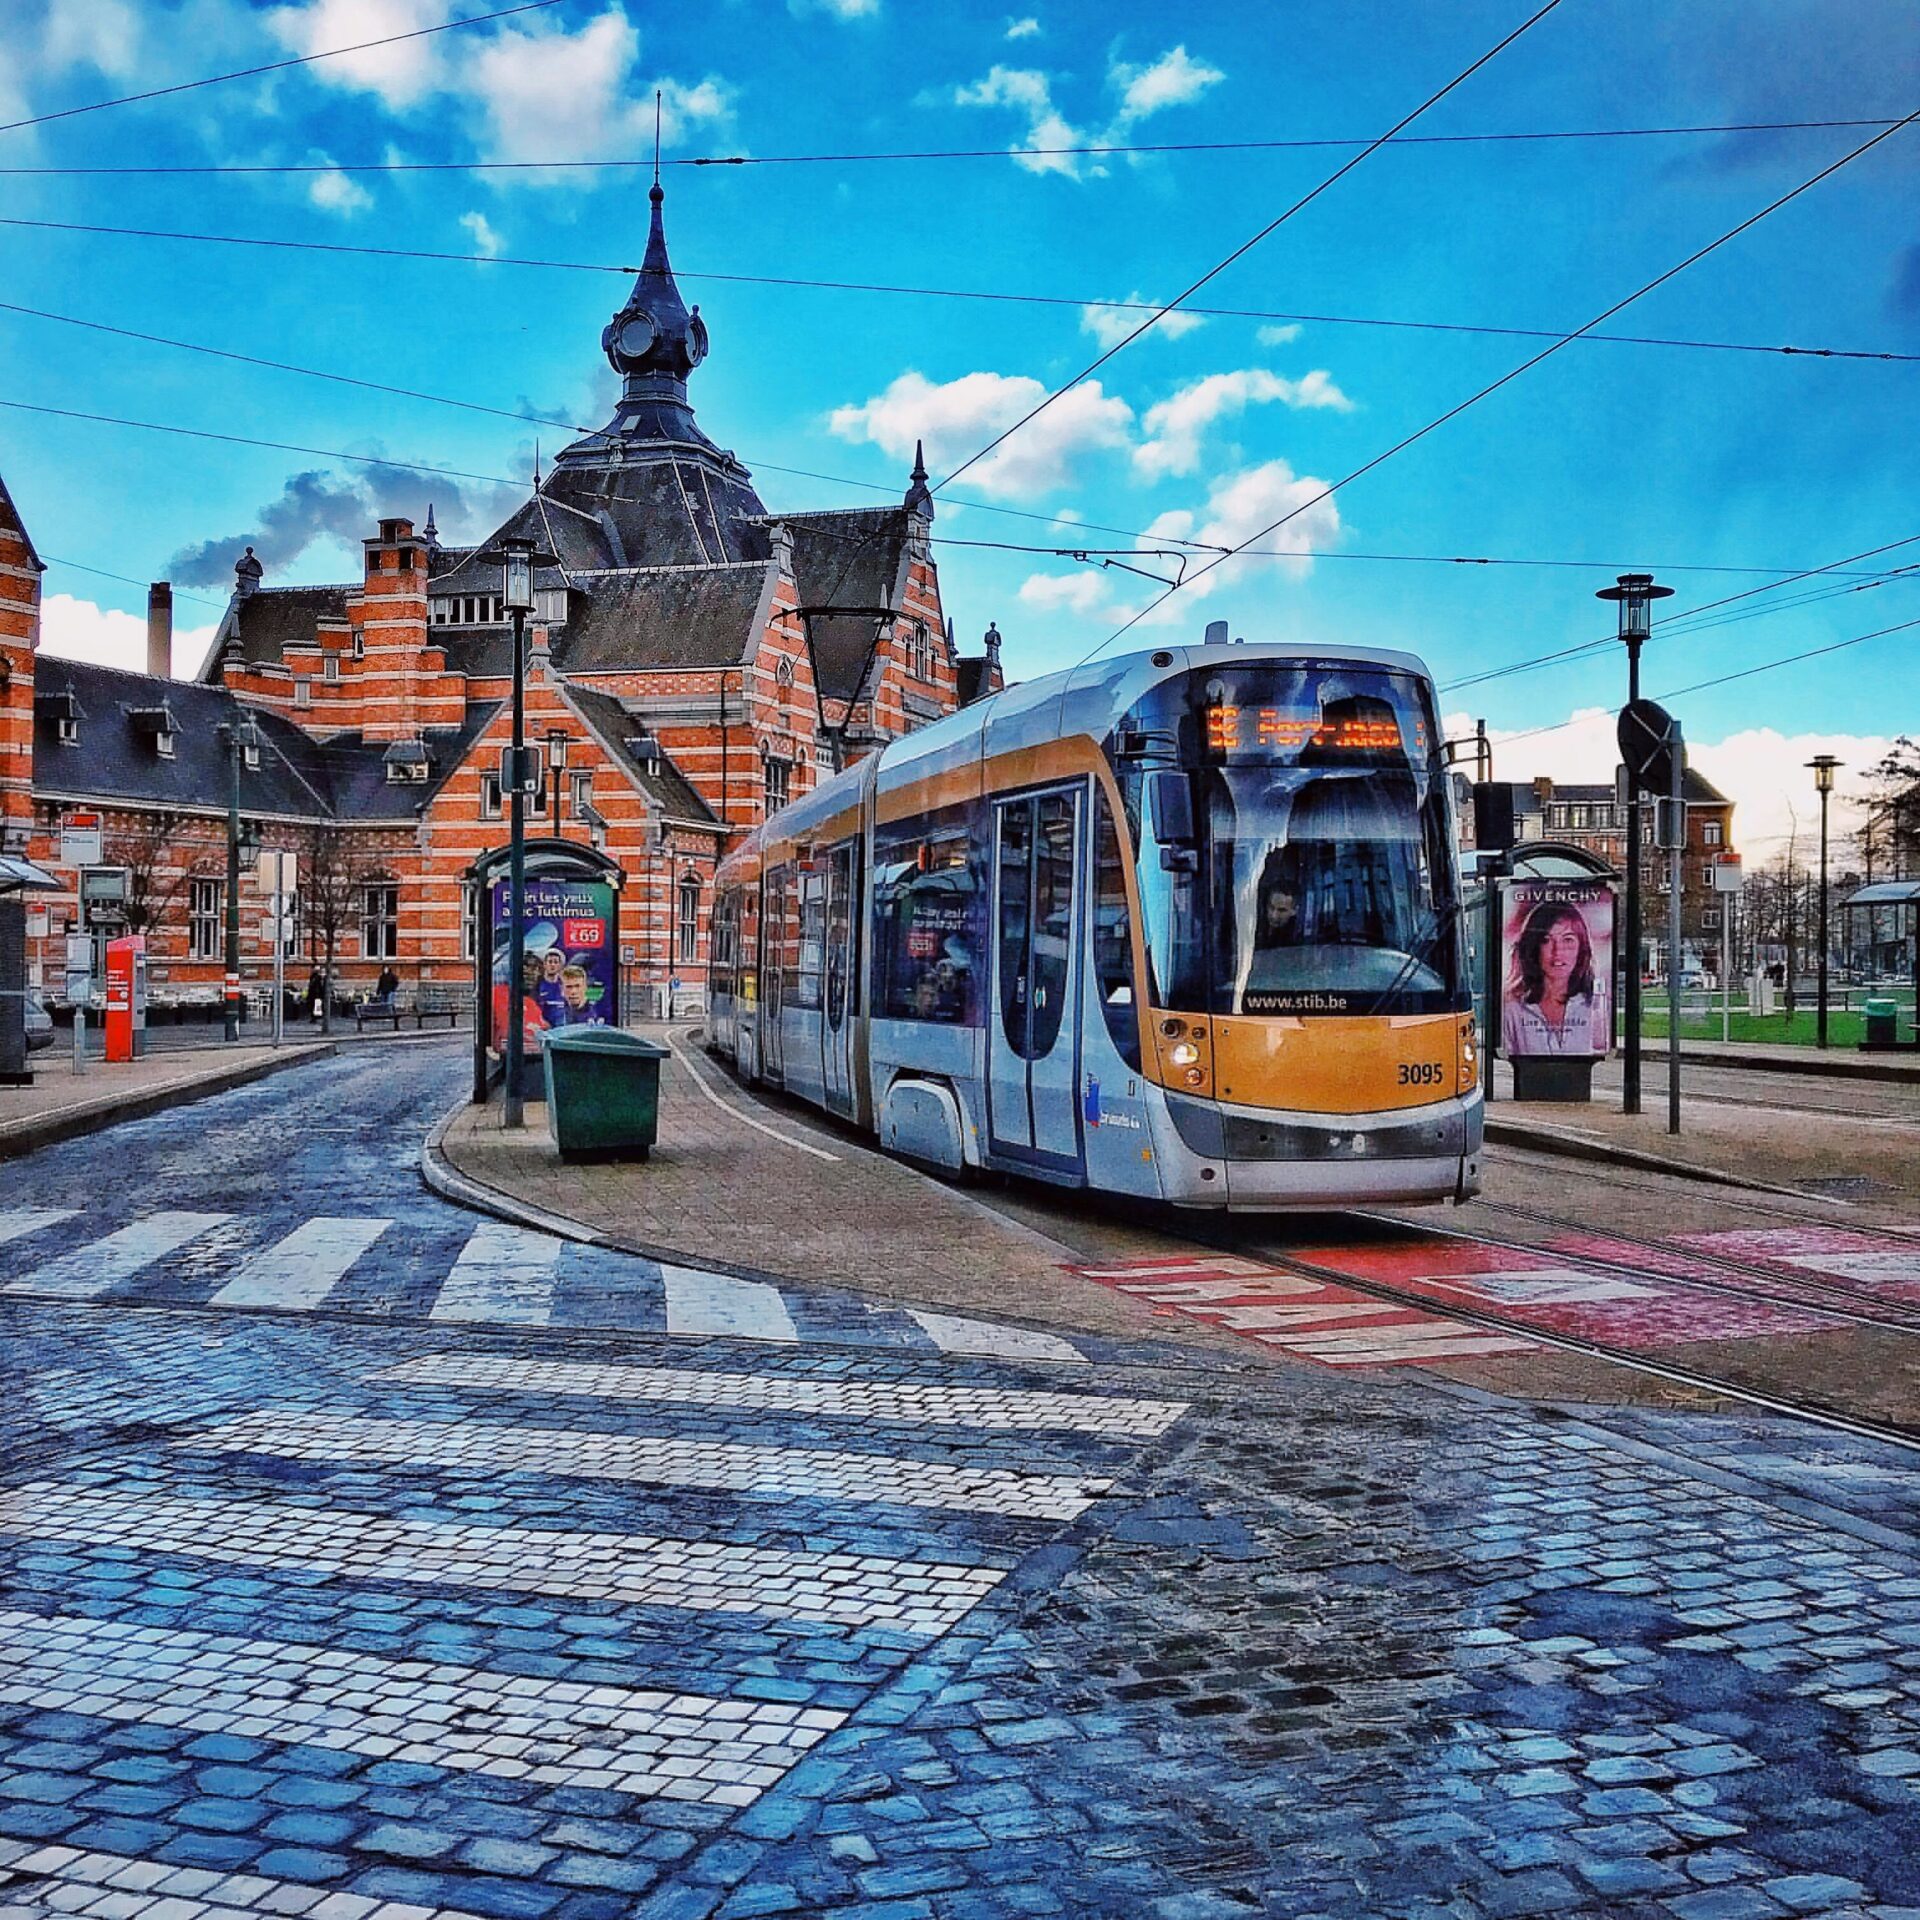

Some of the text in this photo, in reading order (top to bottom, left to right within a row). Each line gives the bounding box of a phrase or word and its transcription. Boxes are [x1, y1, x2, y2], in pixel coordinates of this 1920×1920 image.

[1514, 889, 1601, 902] GIVENCHY
[1247, 994, 1347, 1010] www.stib.be
[1398, 1063, 1443, 1085] 3095
